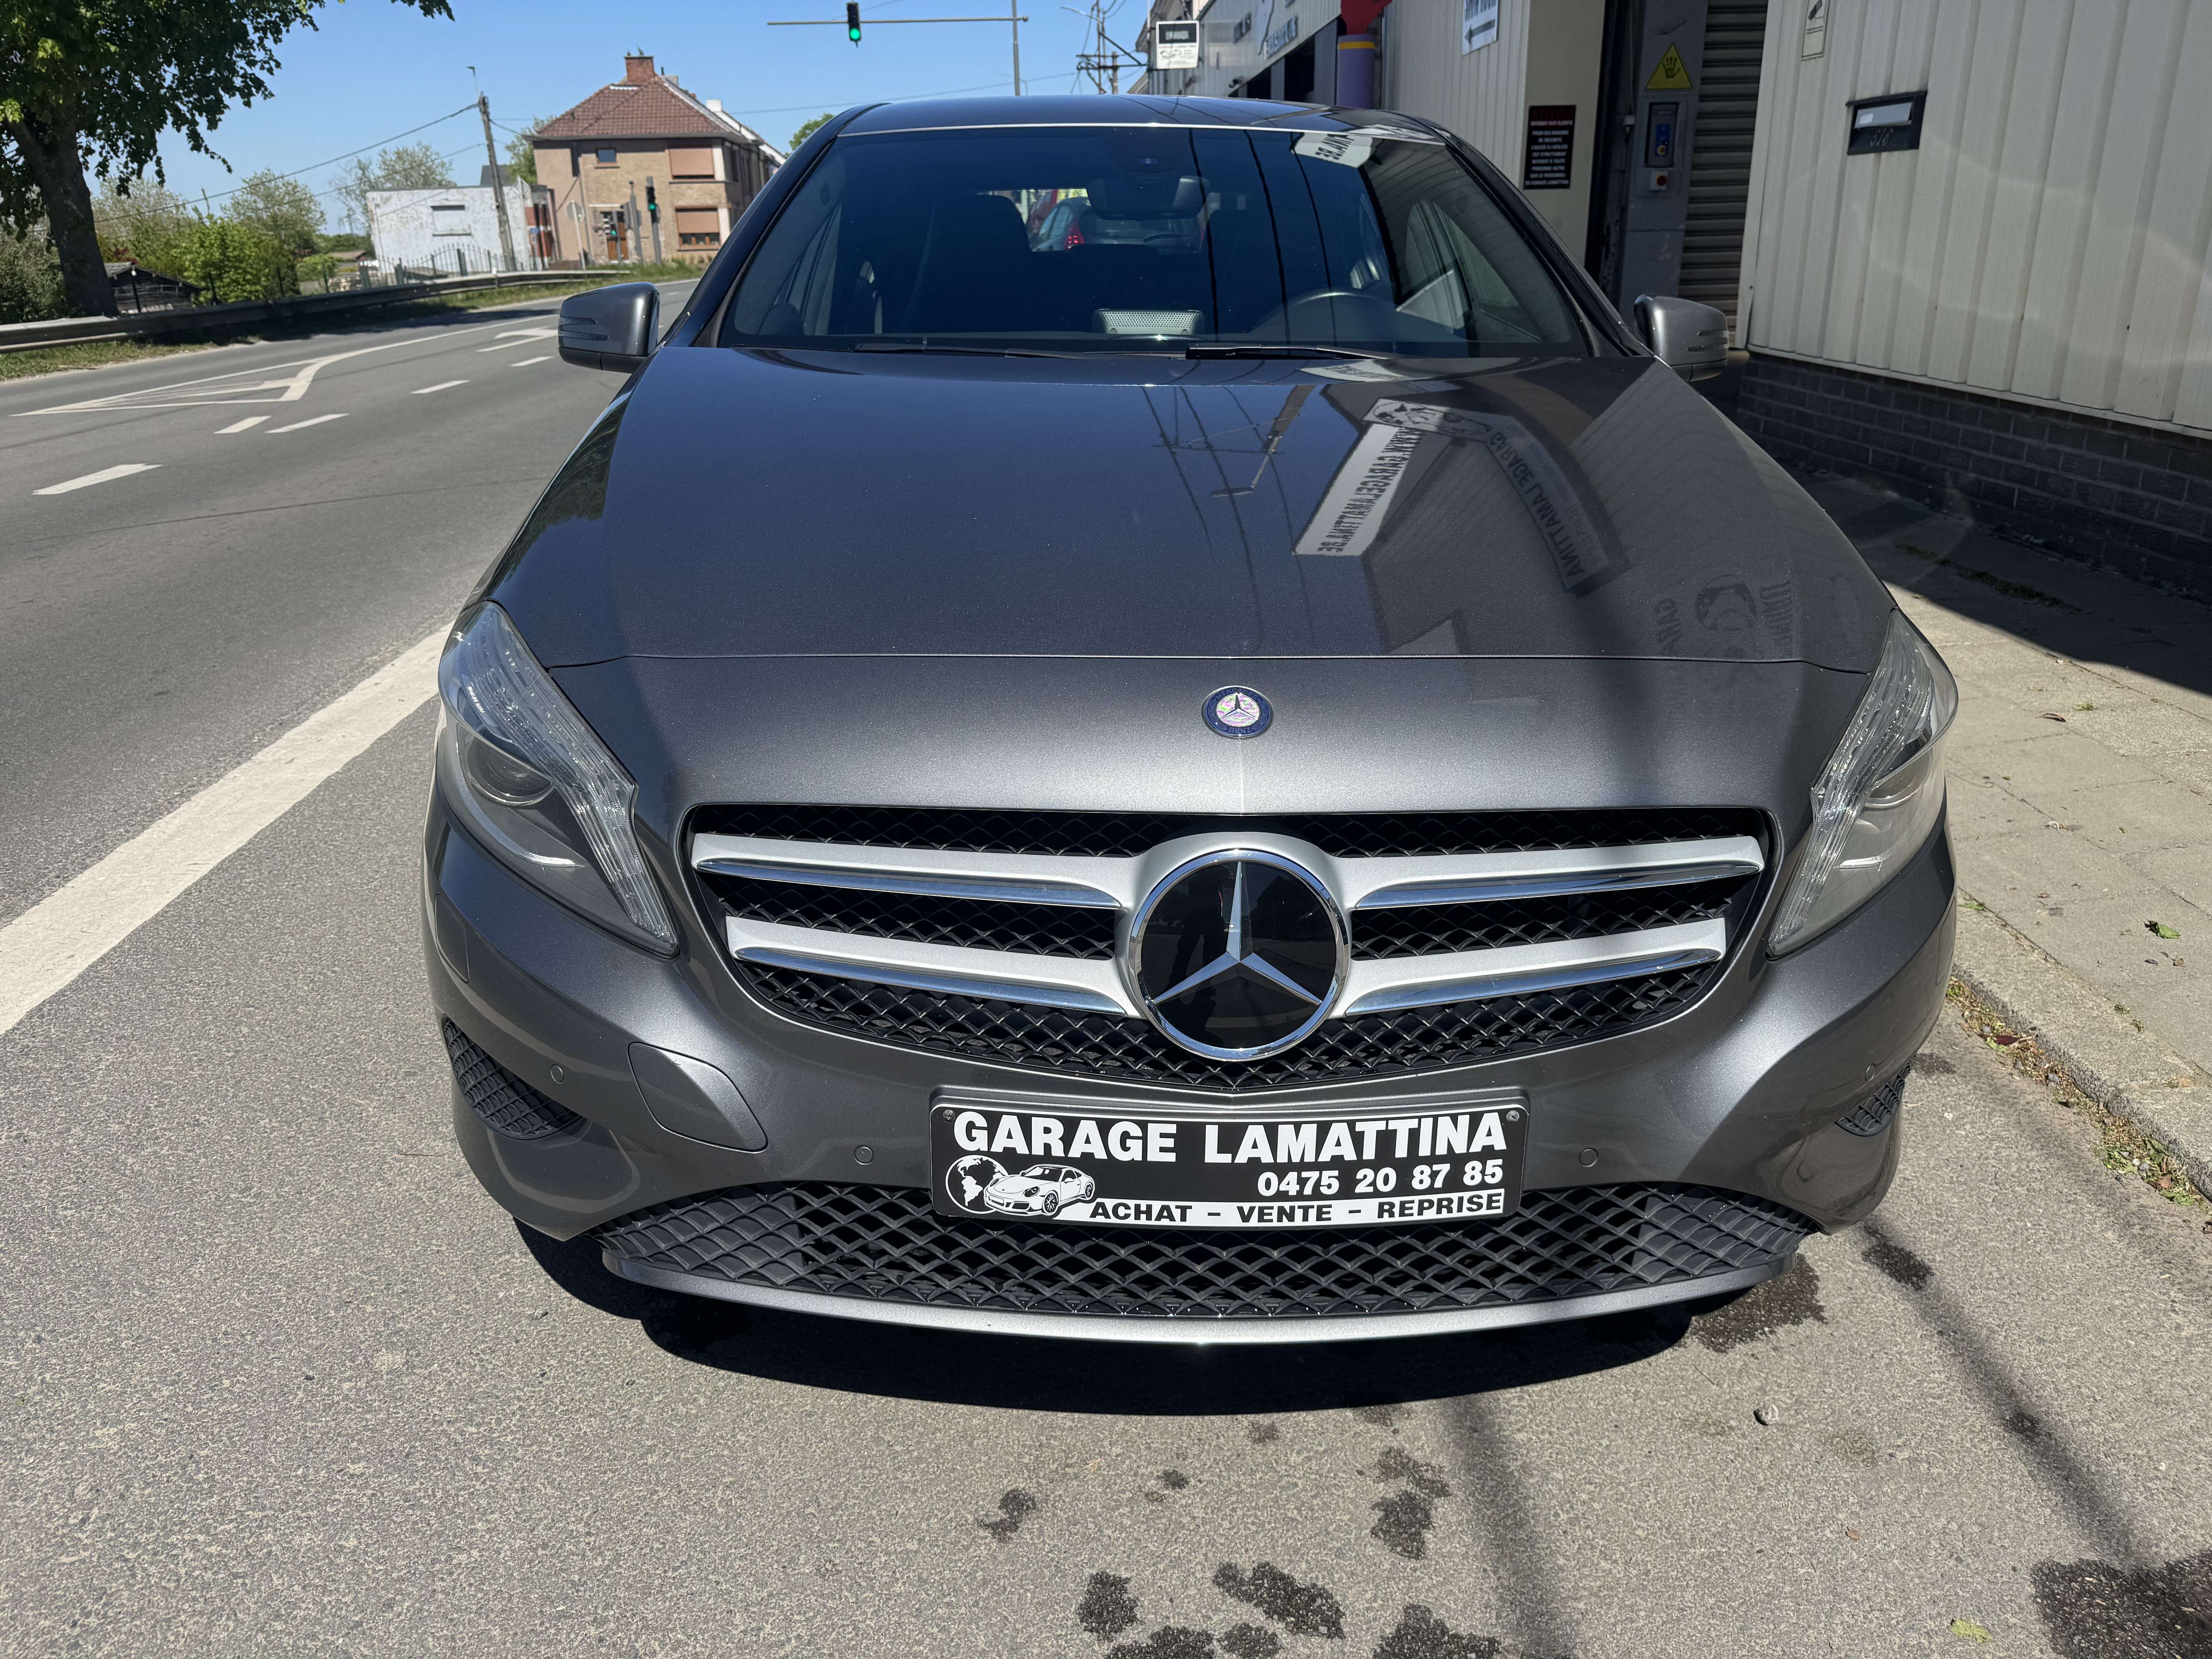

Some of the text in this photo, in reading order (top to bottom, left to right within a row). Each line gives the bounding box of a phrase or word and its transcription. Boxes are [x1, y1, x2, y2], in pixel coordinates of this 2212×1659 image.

[1215, 689, 1259, 699] MERCEDES
[954, 1111, 1507, 1163] GARAGE LAMATTINA
[1257, 1159, 1503, 1197] 0475 20 87 85
[1089, 1202, 1192, 1222] ACHAT
[1237, 1204, 1332, 1223] VENTE
[1377, 1192, 1503, 1219] REPRISE
